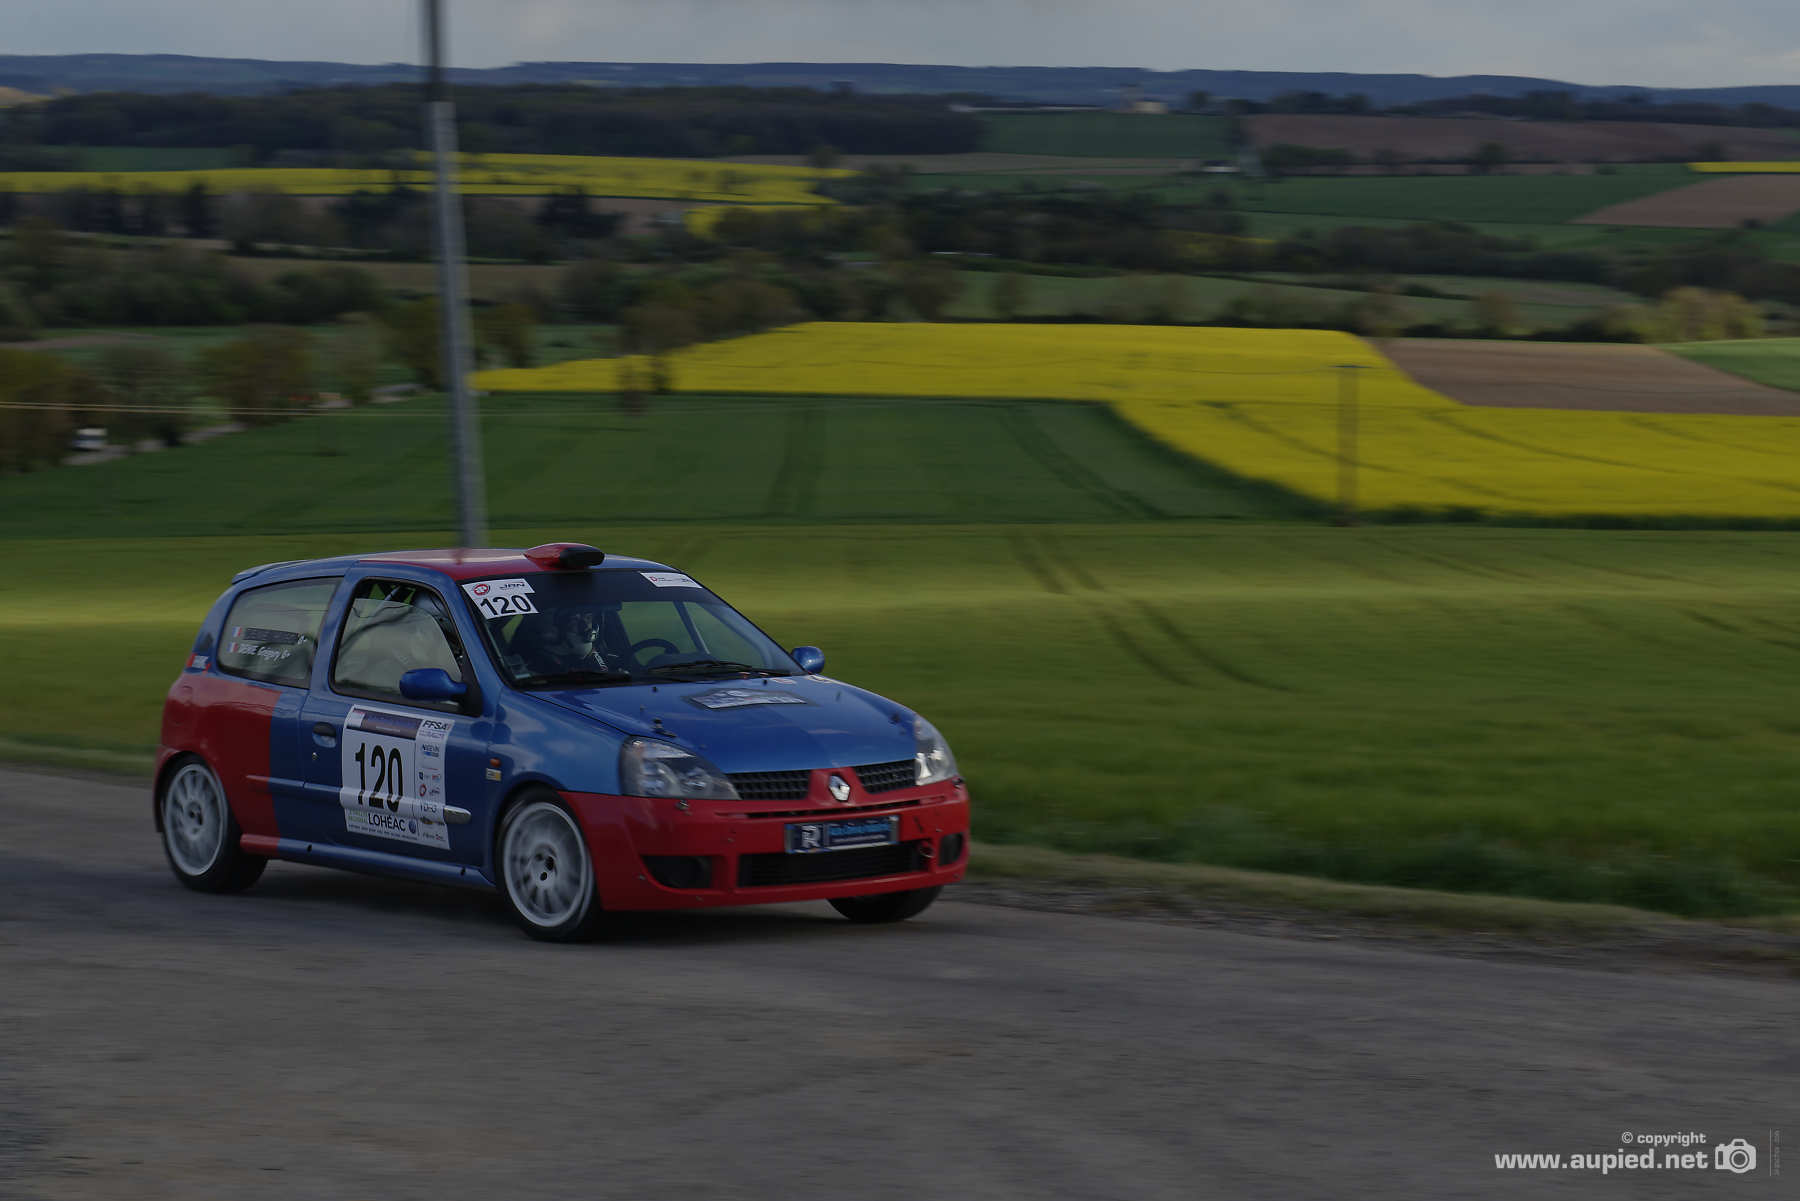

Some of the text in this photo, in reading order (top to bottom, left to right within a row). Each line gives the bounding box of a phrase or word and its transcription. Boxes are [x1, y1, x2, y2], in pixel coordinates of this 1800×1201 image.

[480, 595, 531, 616] 120
[423, 720, 447, 730] FFSA
[355, 743, 403, 812] 120
[368, 813, 406, 832] LOHÉAC
